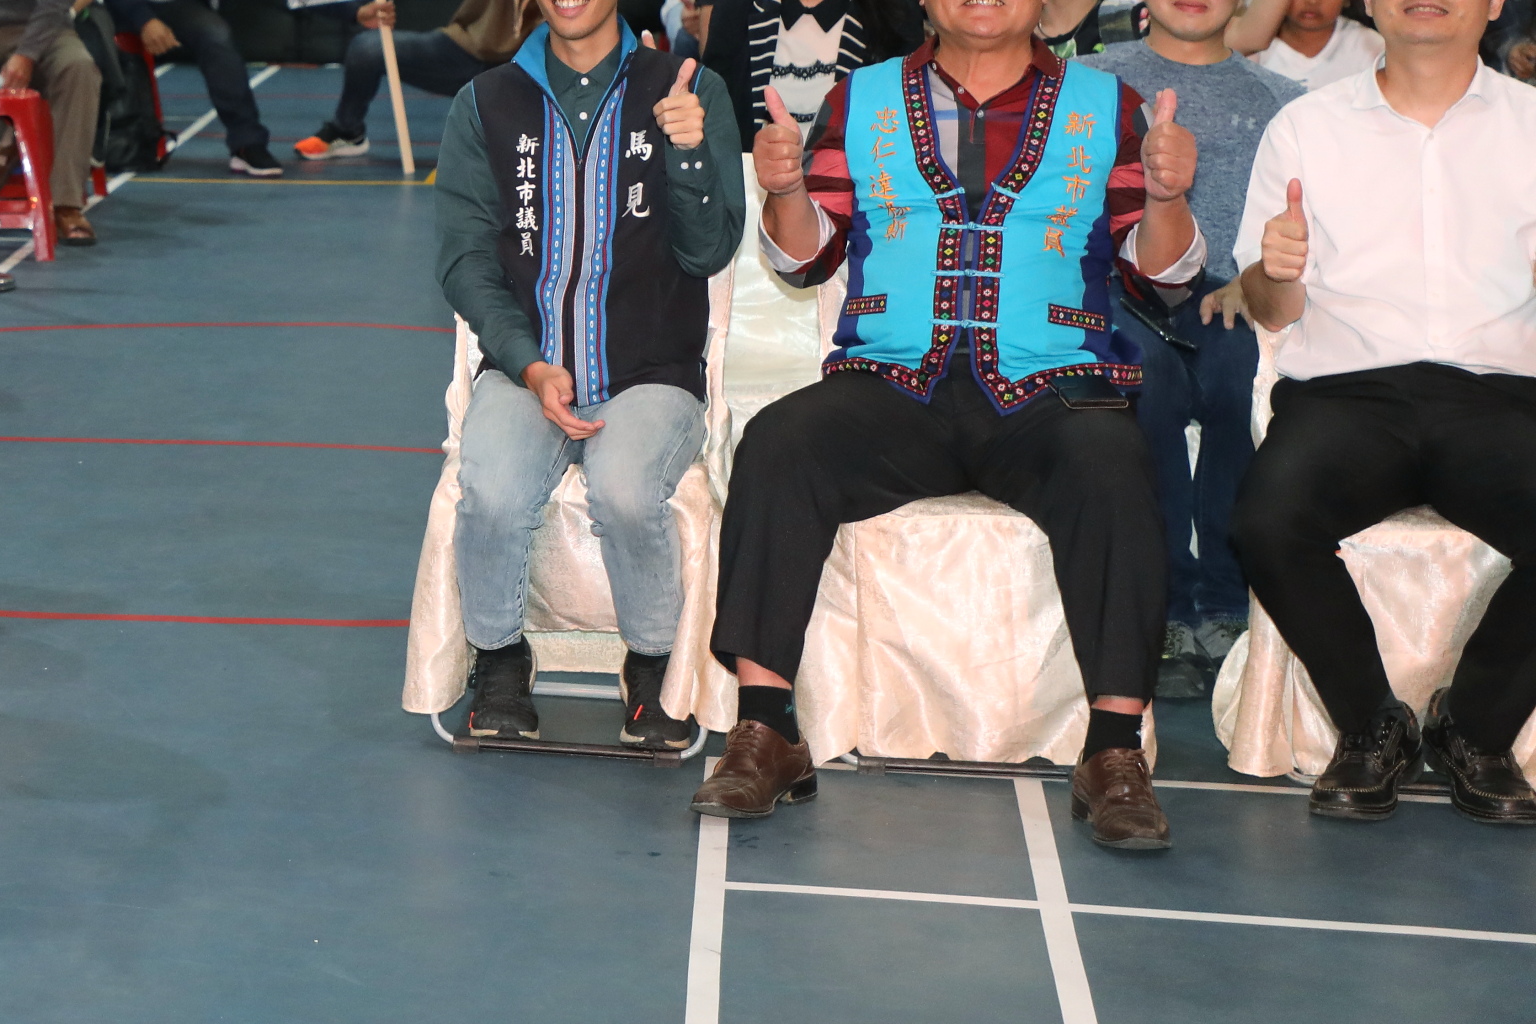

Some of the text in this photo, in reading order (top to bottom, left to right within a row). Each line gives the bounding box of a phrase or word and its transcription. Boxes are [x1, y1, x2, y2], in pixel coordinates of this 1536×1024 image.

[515, 133, 540, 257] 新北市議員
